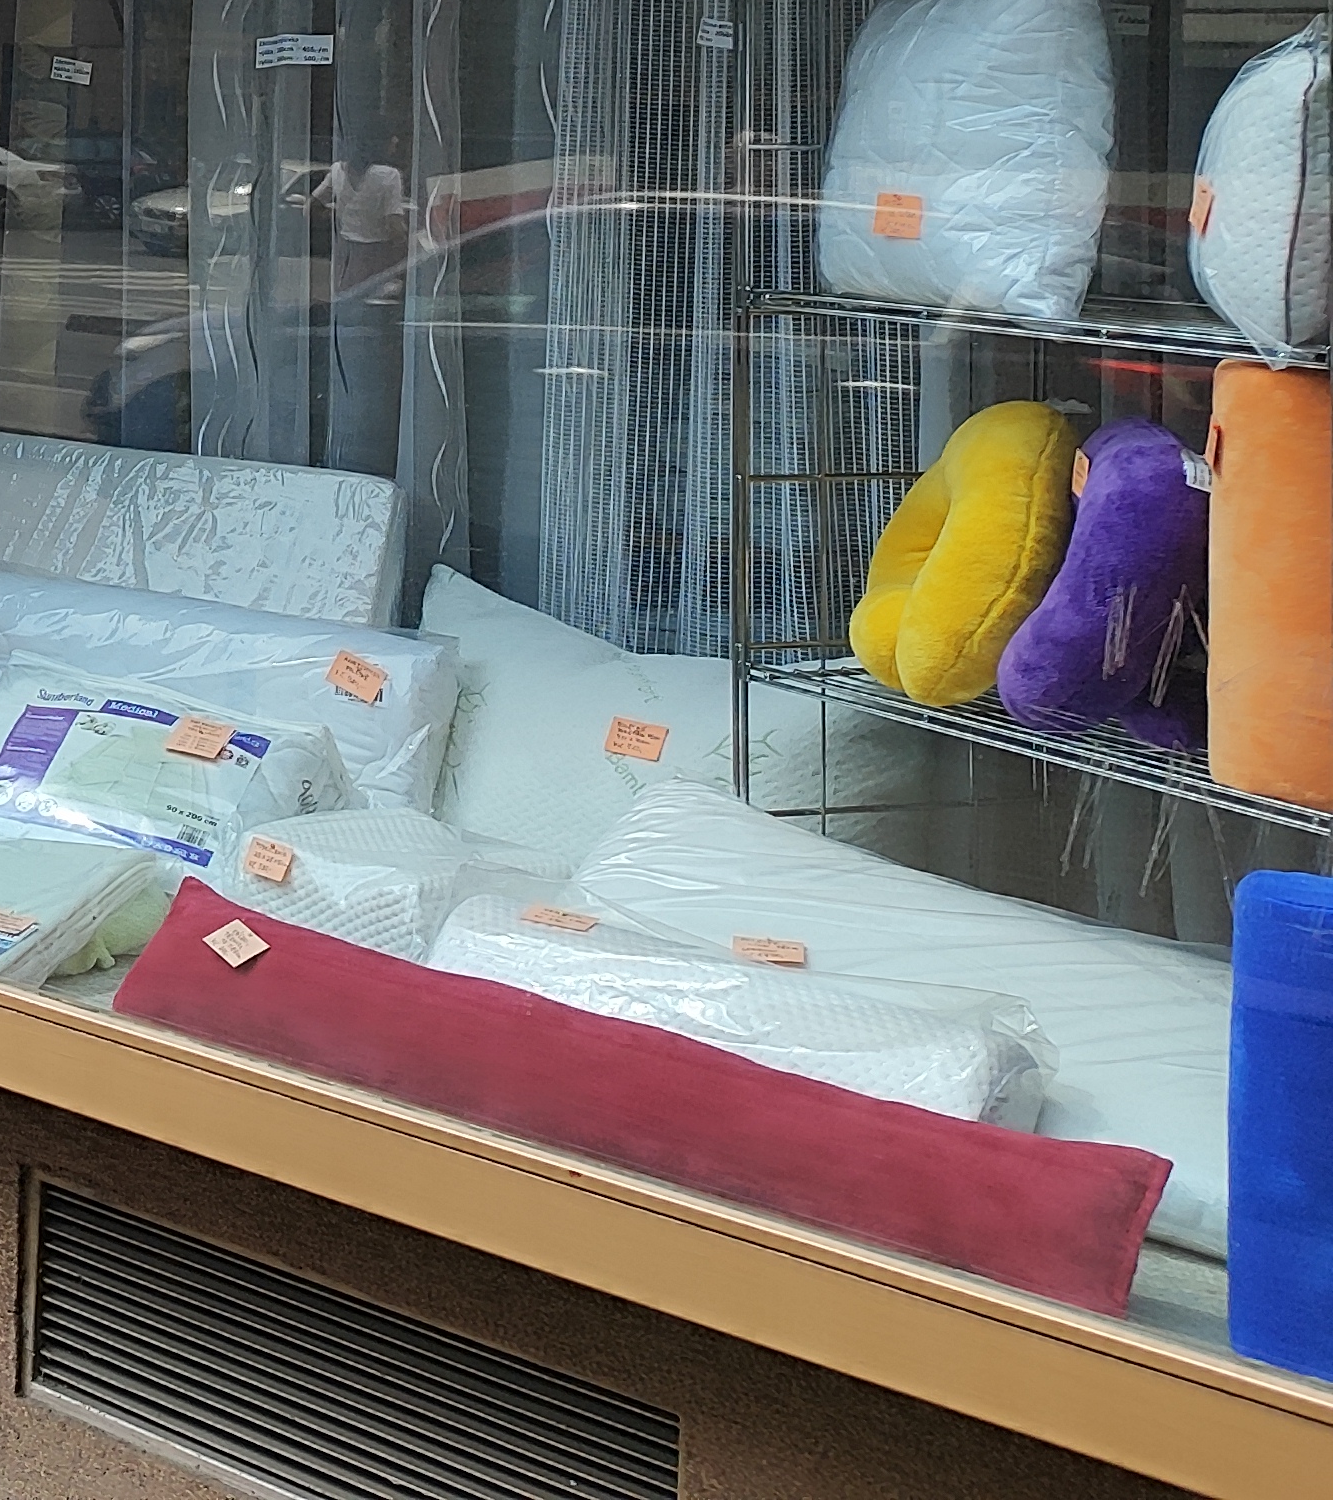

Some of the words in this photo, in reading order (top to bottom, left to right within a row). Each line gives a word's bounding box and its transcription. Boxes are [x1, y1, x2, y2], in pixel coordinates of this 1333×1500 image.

[36, 688, 96, 707] Slumberland
[108, 700, 160, 718] Medical
[166, 803, 178, 815] 90
[204, 817, 218, 827] cm
